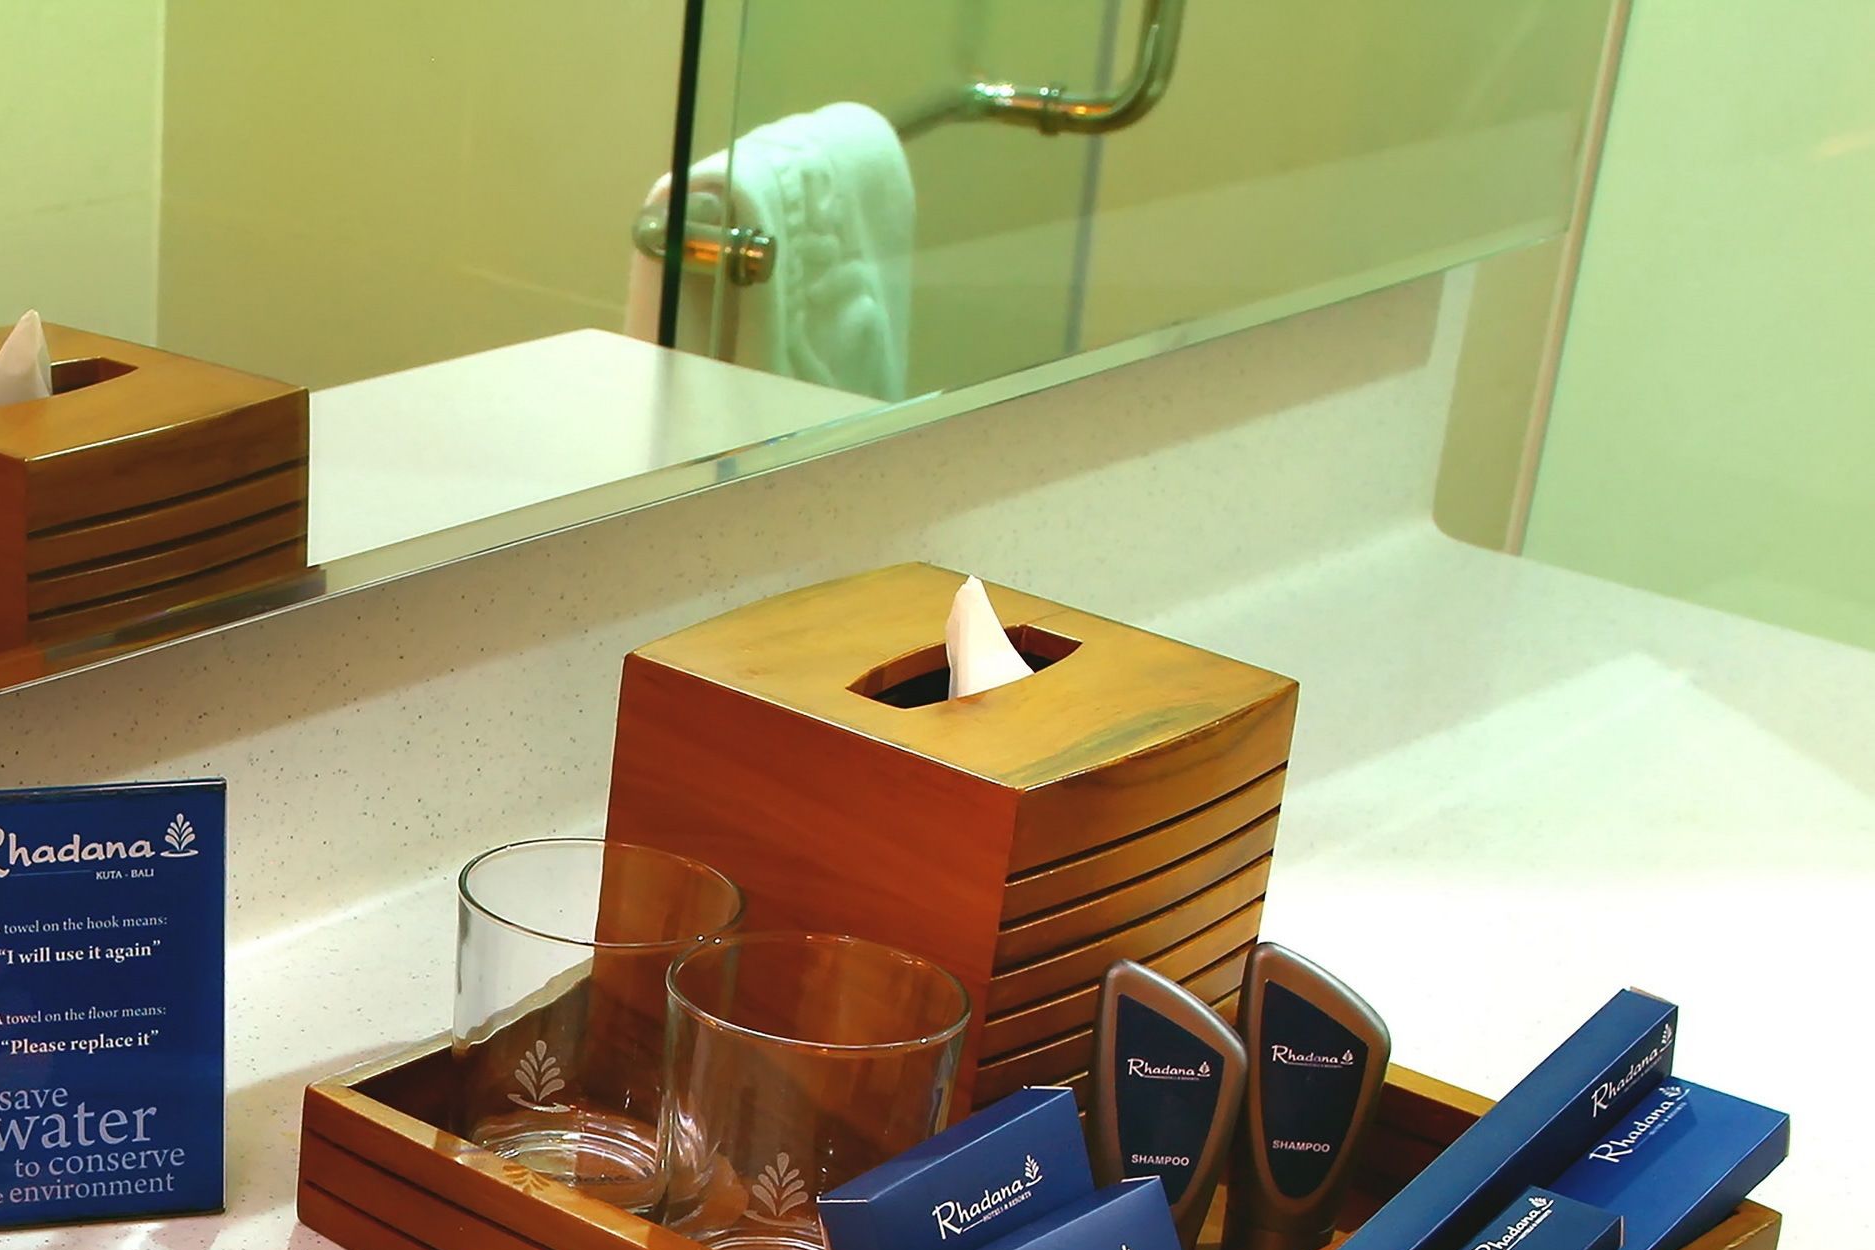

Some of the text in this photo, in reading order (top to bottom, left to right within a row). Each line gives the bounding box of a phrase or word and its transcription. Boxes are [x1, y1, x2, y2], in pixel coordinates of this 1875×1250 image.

[96, 869, 122, 880] KUTA
[130, 868, 154, 879] BALI
[5, 920, 39, 934] towel
[42, 923, 60, 932] on
[63, 918, 83, 931] the
[87, 915, 120, 930] hook
[123, 916, 168, 928] means:
[19, 947, 51, 964] will
[55, 949, 84, 962] use
[89, 945, 101, 960] it
[6, 1010, 41, 1025] towel
[44, 1014, 61, 1023] on
[65, 1008, 85, 1021] the
[88, 1006, 118, 1020] floor
[122, 1006, 166, 1018] means:
[70, 1034, 134, 1055] replace
[1271, 1045, 1339, 1064] Rhadana
[1127, 1058, 1195, 1078] Rhadana
[1591, 1048, 1658, 1118] Rhadana
[1589, 1101, 1675, 1163] Rhadana
[1272, 1139, 1330, 1153] SHAMPOO
[14, 1146, 185, 1178] to conserve
[1131, 1154, 1190, 1167] SHAMPOO
[9, 1173, 174, 1204] environment
[932, 1178, 1024, 1239] Rhadana
